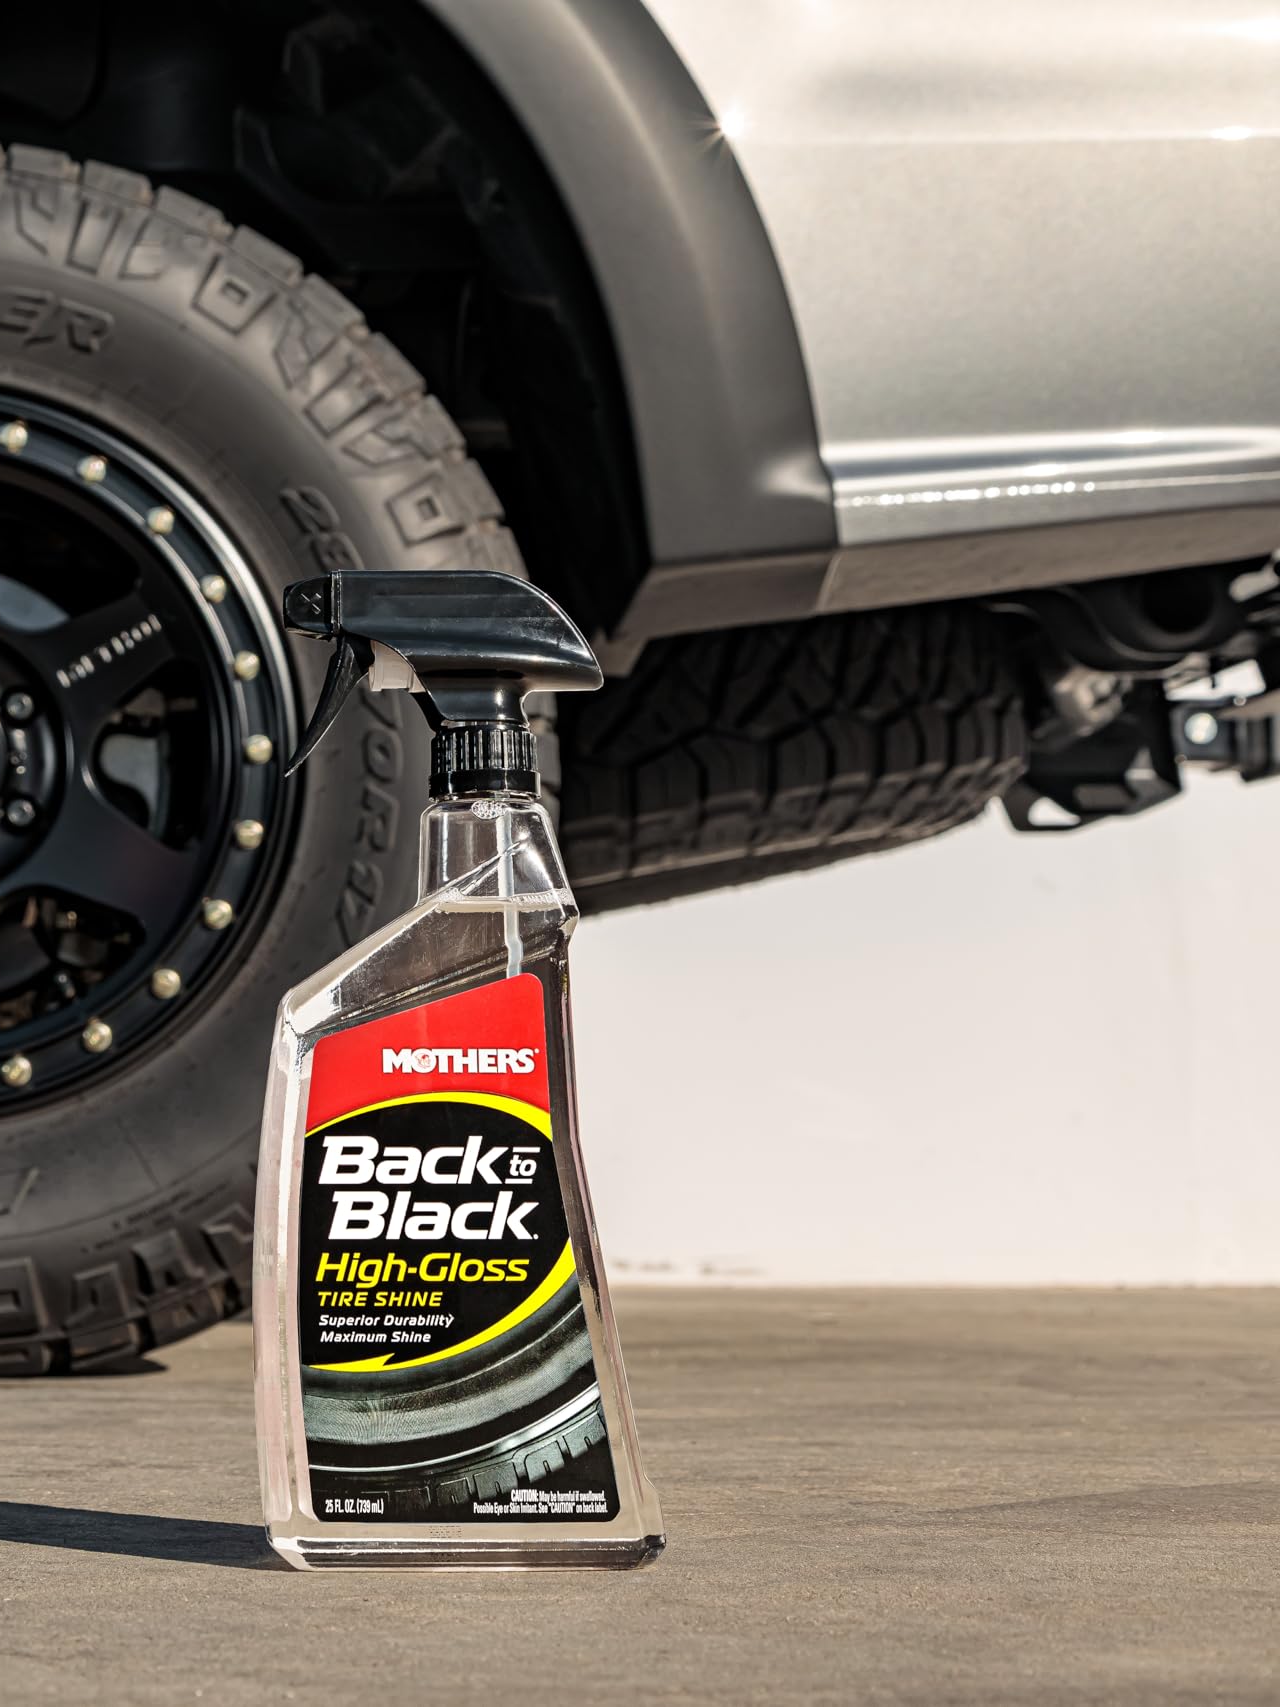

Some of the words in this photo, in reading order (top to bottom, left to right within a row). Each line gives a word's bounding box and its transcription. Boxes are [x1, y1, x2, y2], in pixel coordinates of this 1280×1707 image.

[383, 1048, 535, 1073] MOTHERS
[318, 1135, 509, 1185] Back
[510, 1154, 537, 1177] to
[315, 1252, 530, 1288] High-Gloss
[318, 1291, 369, 1307] TIRE
[373, 1291, 443, 1307] SHINE
[318, 1314, 381, 1328] Superior
[383, 1313, 455, 1329] Durability
[320, 1330, 388, 1343] Maximum
[390, 1331, 432, 1343] Shine
[511, 1489, 539, 1502] CAUTION:
[539, 1490, 550, 1504] May
[550, 1490, 557, 1501] be
[557, 1490, 575, 1501] harmful
[580, 1490, 606, 1501] swallowed.
[325, 1499, 333, 1513] 25
[334, 1499, 344, 1513] FL.
[344, 1499, 356, 1513] OZ.
[356, 1498, 371, 1514] (739
[371, 1498, 384, 1514] mL)
[473, 1502, 493, 1513] Possible
[493, 1502, 503, 1516] Eye
[503, 1505, 509, 1513] or
[509, 1502, 520, 1513] Skin
[538, 1502, 548, 1513] See
[575, 1504, 582, 1513] on
[582, 1502, 594, 1513] back
[594, 1502, 608, 1513] label.
